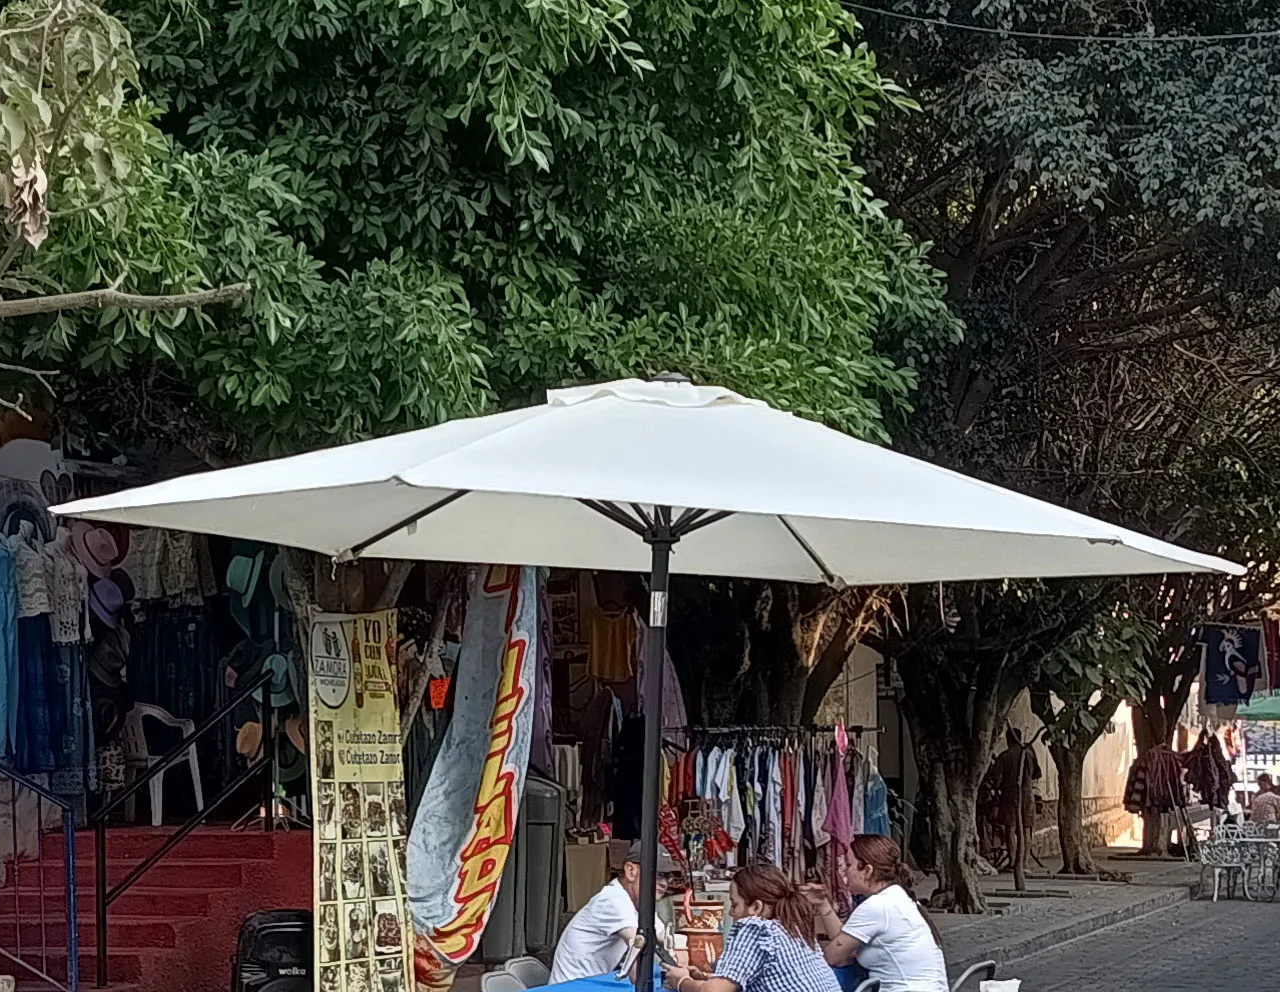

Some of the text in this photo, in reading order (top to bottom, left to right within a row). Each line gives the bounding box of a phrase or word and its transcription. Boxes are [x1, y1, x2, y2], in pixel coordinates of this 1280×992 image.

[363, 618, 382, 645] YO
[364, 644, 382, 661] CON
[315, 658, 347, 676] ZAMORA
